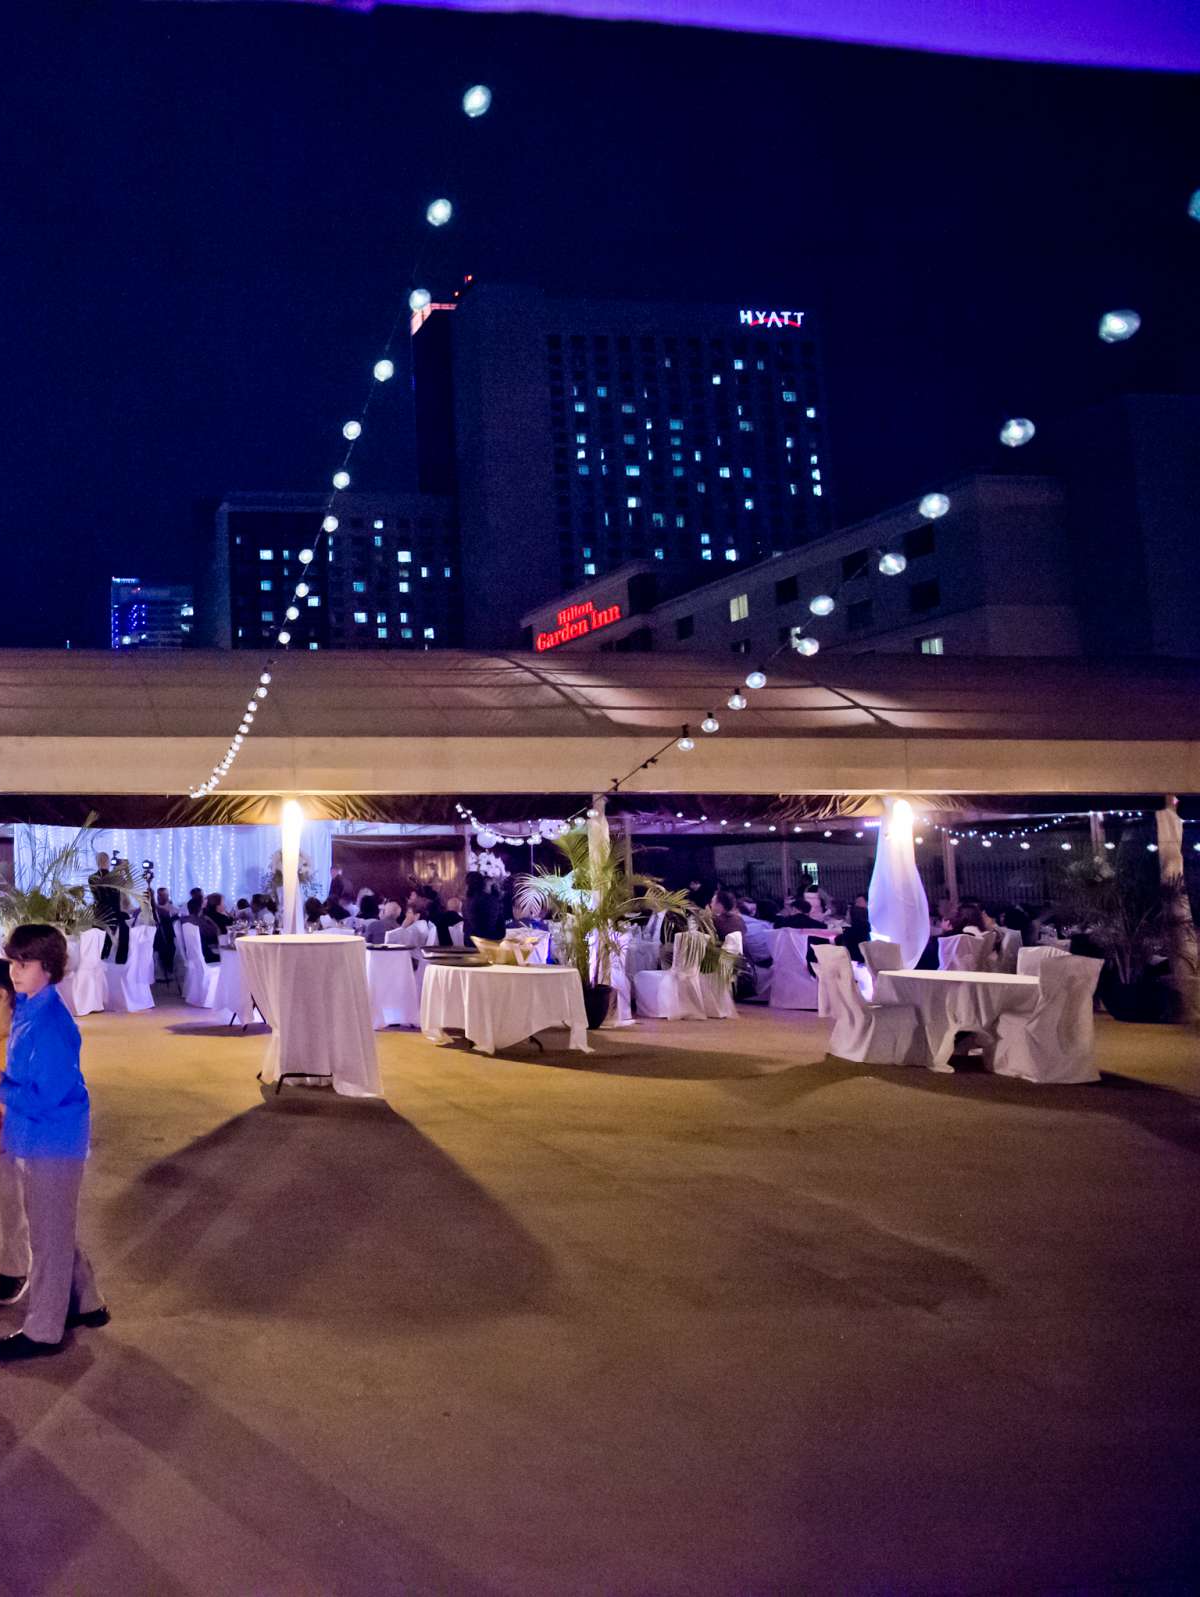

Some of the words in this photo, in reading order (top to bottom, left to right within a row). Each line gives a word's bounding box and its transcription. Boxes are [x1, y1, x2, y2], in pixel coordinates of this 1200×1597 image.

[739, 309, 805, 328] HYATT
[557, 601, 593, 626] Hilton
[536, 619, 589, 651] Garden
[591, 605, 621, 630] Inn
